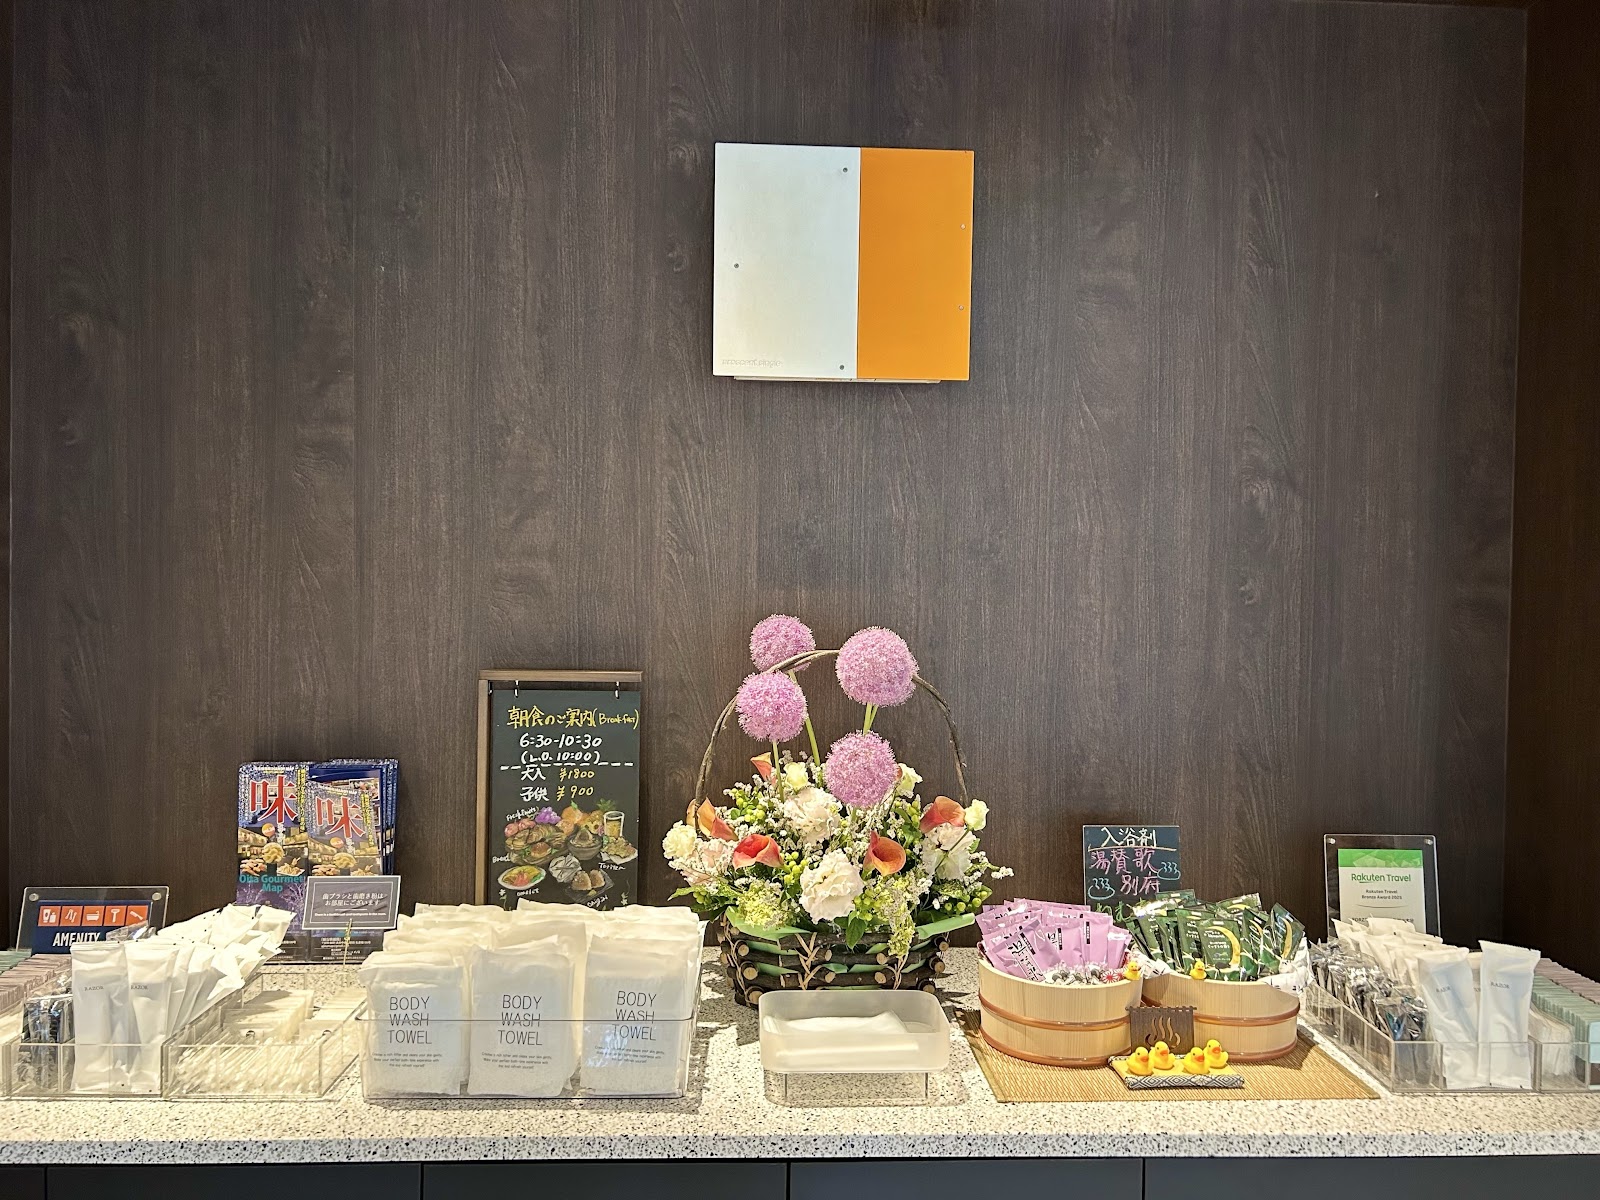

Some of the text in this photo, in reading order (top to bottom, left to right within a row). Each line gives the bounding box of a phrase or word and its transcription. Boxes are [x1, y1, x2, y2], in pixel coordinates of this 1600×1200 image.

[519, 732, 603, 750] 6:30-10:30
[520, 767, 547, 781] 大人
[250, 774, 299, 824] 味
[520, 786, 550, 802] 子供
[315, 796, 366, 839] 味
[1100, 826, 1157, 848] 入浴剤
[1088, 848, 1159, 875] 湯賛歌
[261, 874, 304, 884] Gourmet
[1120, 871, 1161, 896] 別府
[1351, 873, 1412, 883] Rakuten Travel
[261, 883, 284, 893] Map
[322, 892, 384, 900] 歯ブラシと歯磨き粉は
[324, 899, 380, 907] お部屋にございます
[52, 932, 101, 947] AMENITY
[389, 996, 430, 1010] BODY
[502, 994, 542, 1010] BODY
[616, 990, 657, 1007] BODY
[389, 1013, 430, 1026] WASH
[501, 1012, 541, 1027] WASH
[615, 1008, 655, 1024] WASH
[387, 1030, 432, 1044] TOWEL
[498, 1030, 543, 1046] TOWEL
[612, 1023, 656, 1041] TOWEL
